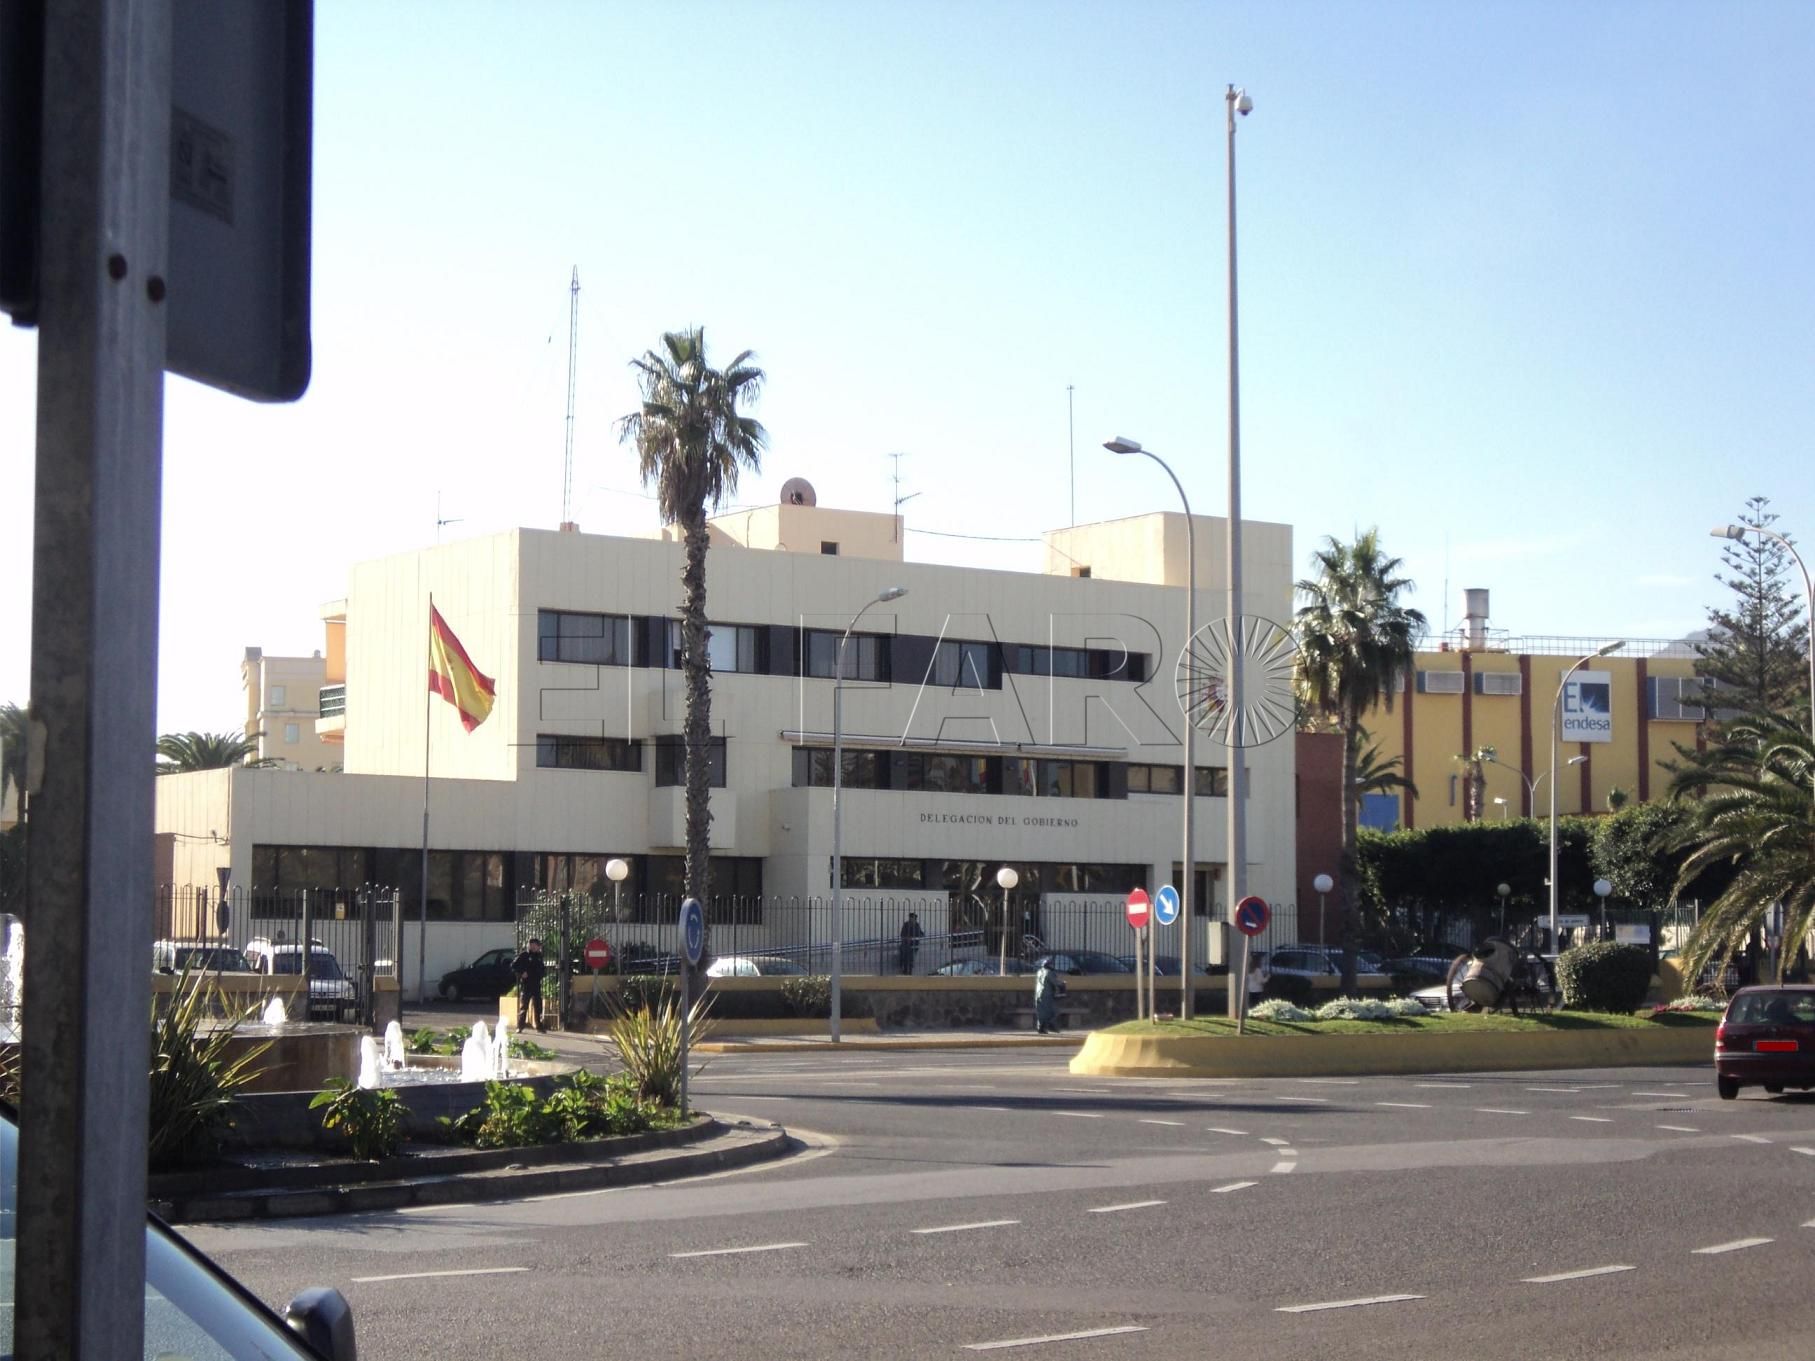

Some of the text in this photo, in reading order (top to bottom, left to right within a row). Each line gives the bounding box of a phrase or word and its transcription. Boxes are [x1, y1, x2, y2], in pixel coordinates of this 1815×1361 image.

[1564, 716, 1610, 730] endesa
[920, 813, 1079, 828] DELEGACION DEL GOBIERNO
